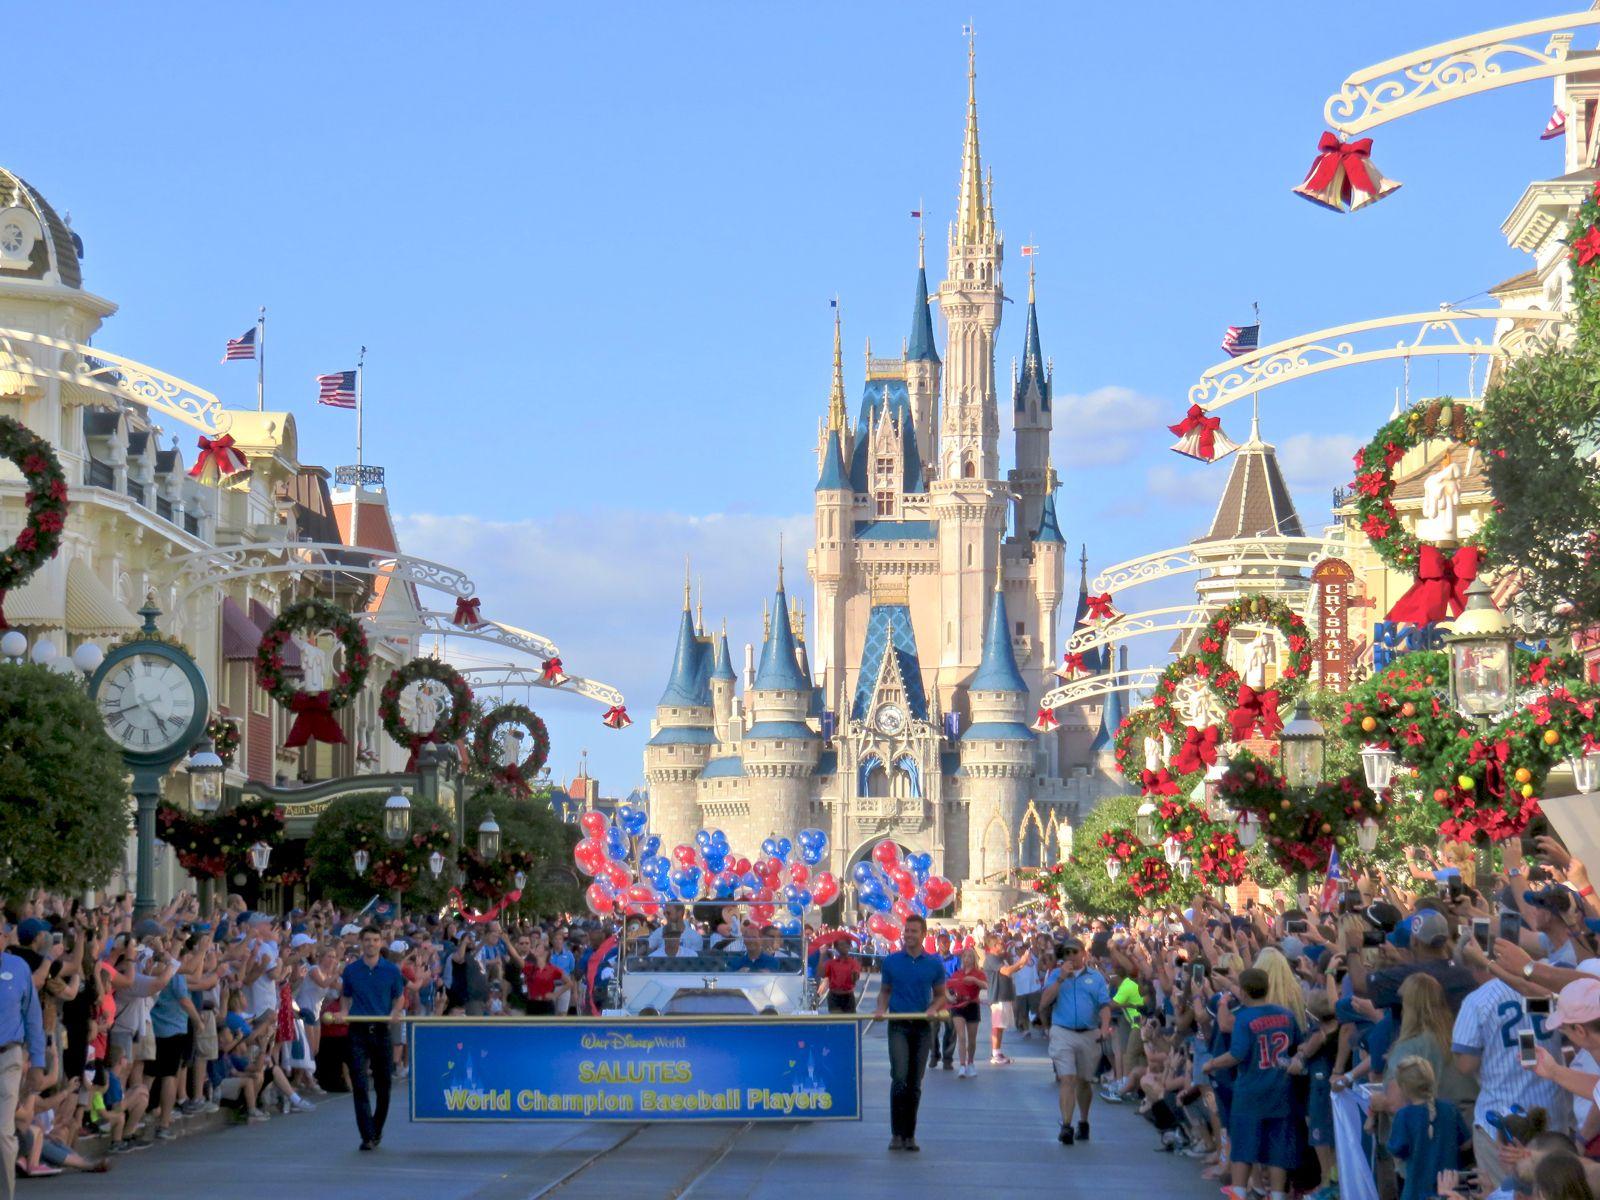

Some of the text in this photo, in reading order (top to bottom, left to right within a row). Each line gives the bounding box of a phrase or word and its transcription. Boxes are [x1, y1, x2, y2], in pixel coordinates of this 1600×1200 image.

[1325, 584, 1341, 661] CRYSTAL
[607, 1031, 655, 1054] Disney
[654, 1036, 687, 1049] World
[1258, 1031, 1290, 1070] 12
[578, 1060, 693, 1084] SALUTES
[443, 1088, 832, 1116] World Champion Baseball Players
